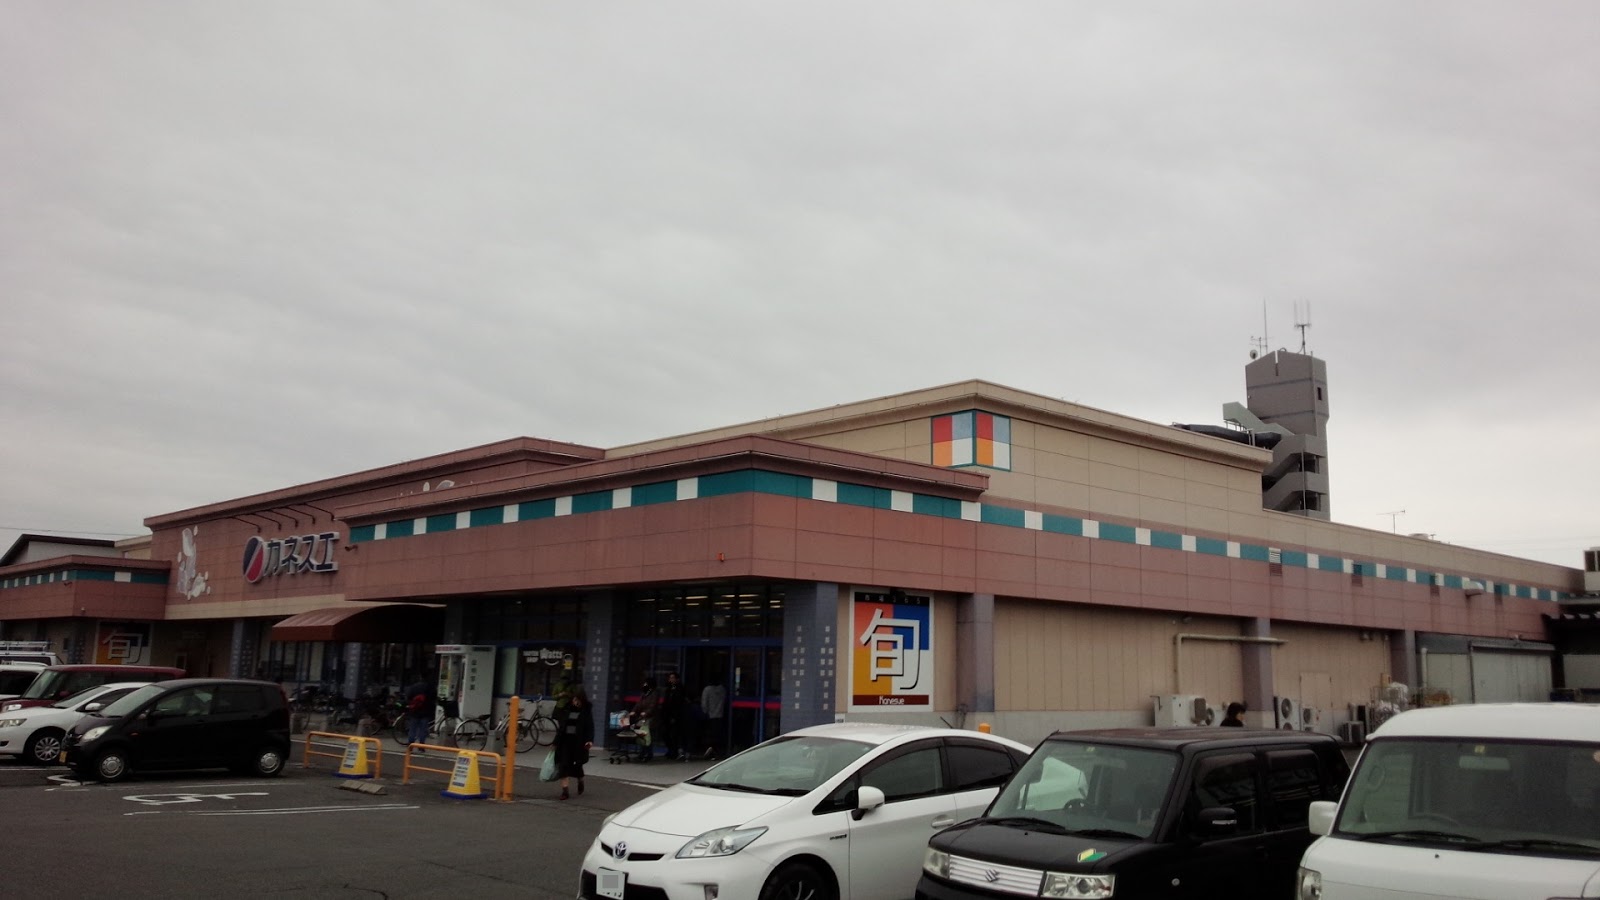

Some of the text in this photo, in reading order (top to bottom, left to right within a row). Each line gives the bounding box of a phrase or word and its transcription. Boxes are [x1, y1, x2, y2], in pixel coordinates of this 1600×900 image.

[263, 532, 340, 576] カネスエ
[102, 629, 144, 664] 旬
[860, 608, 921, 690] 旬
